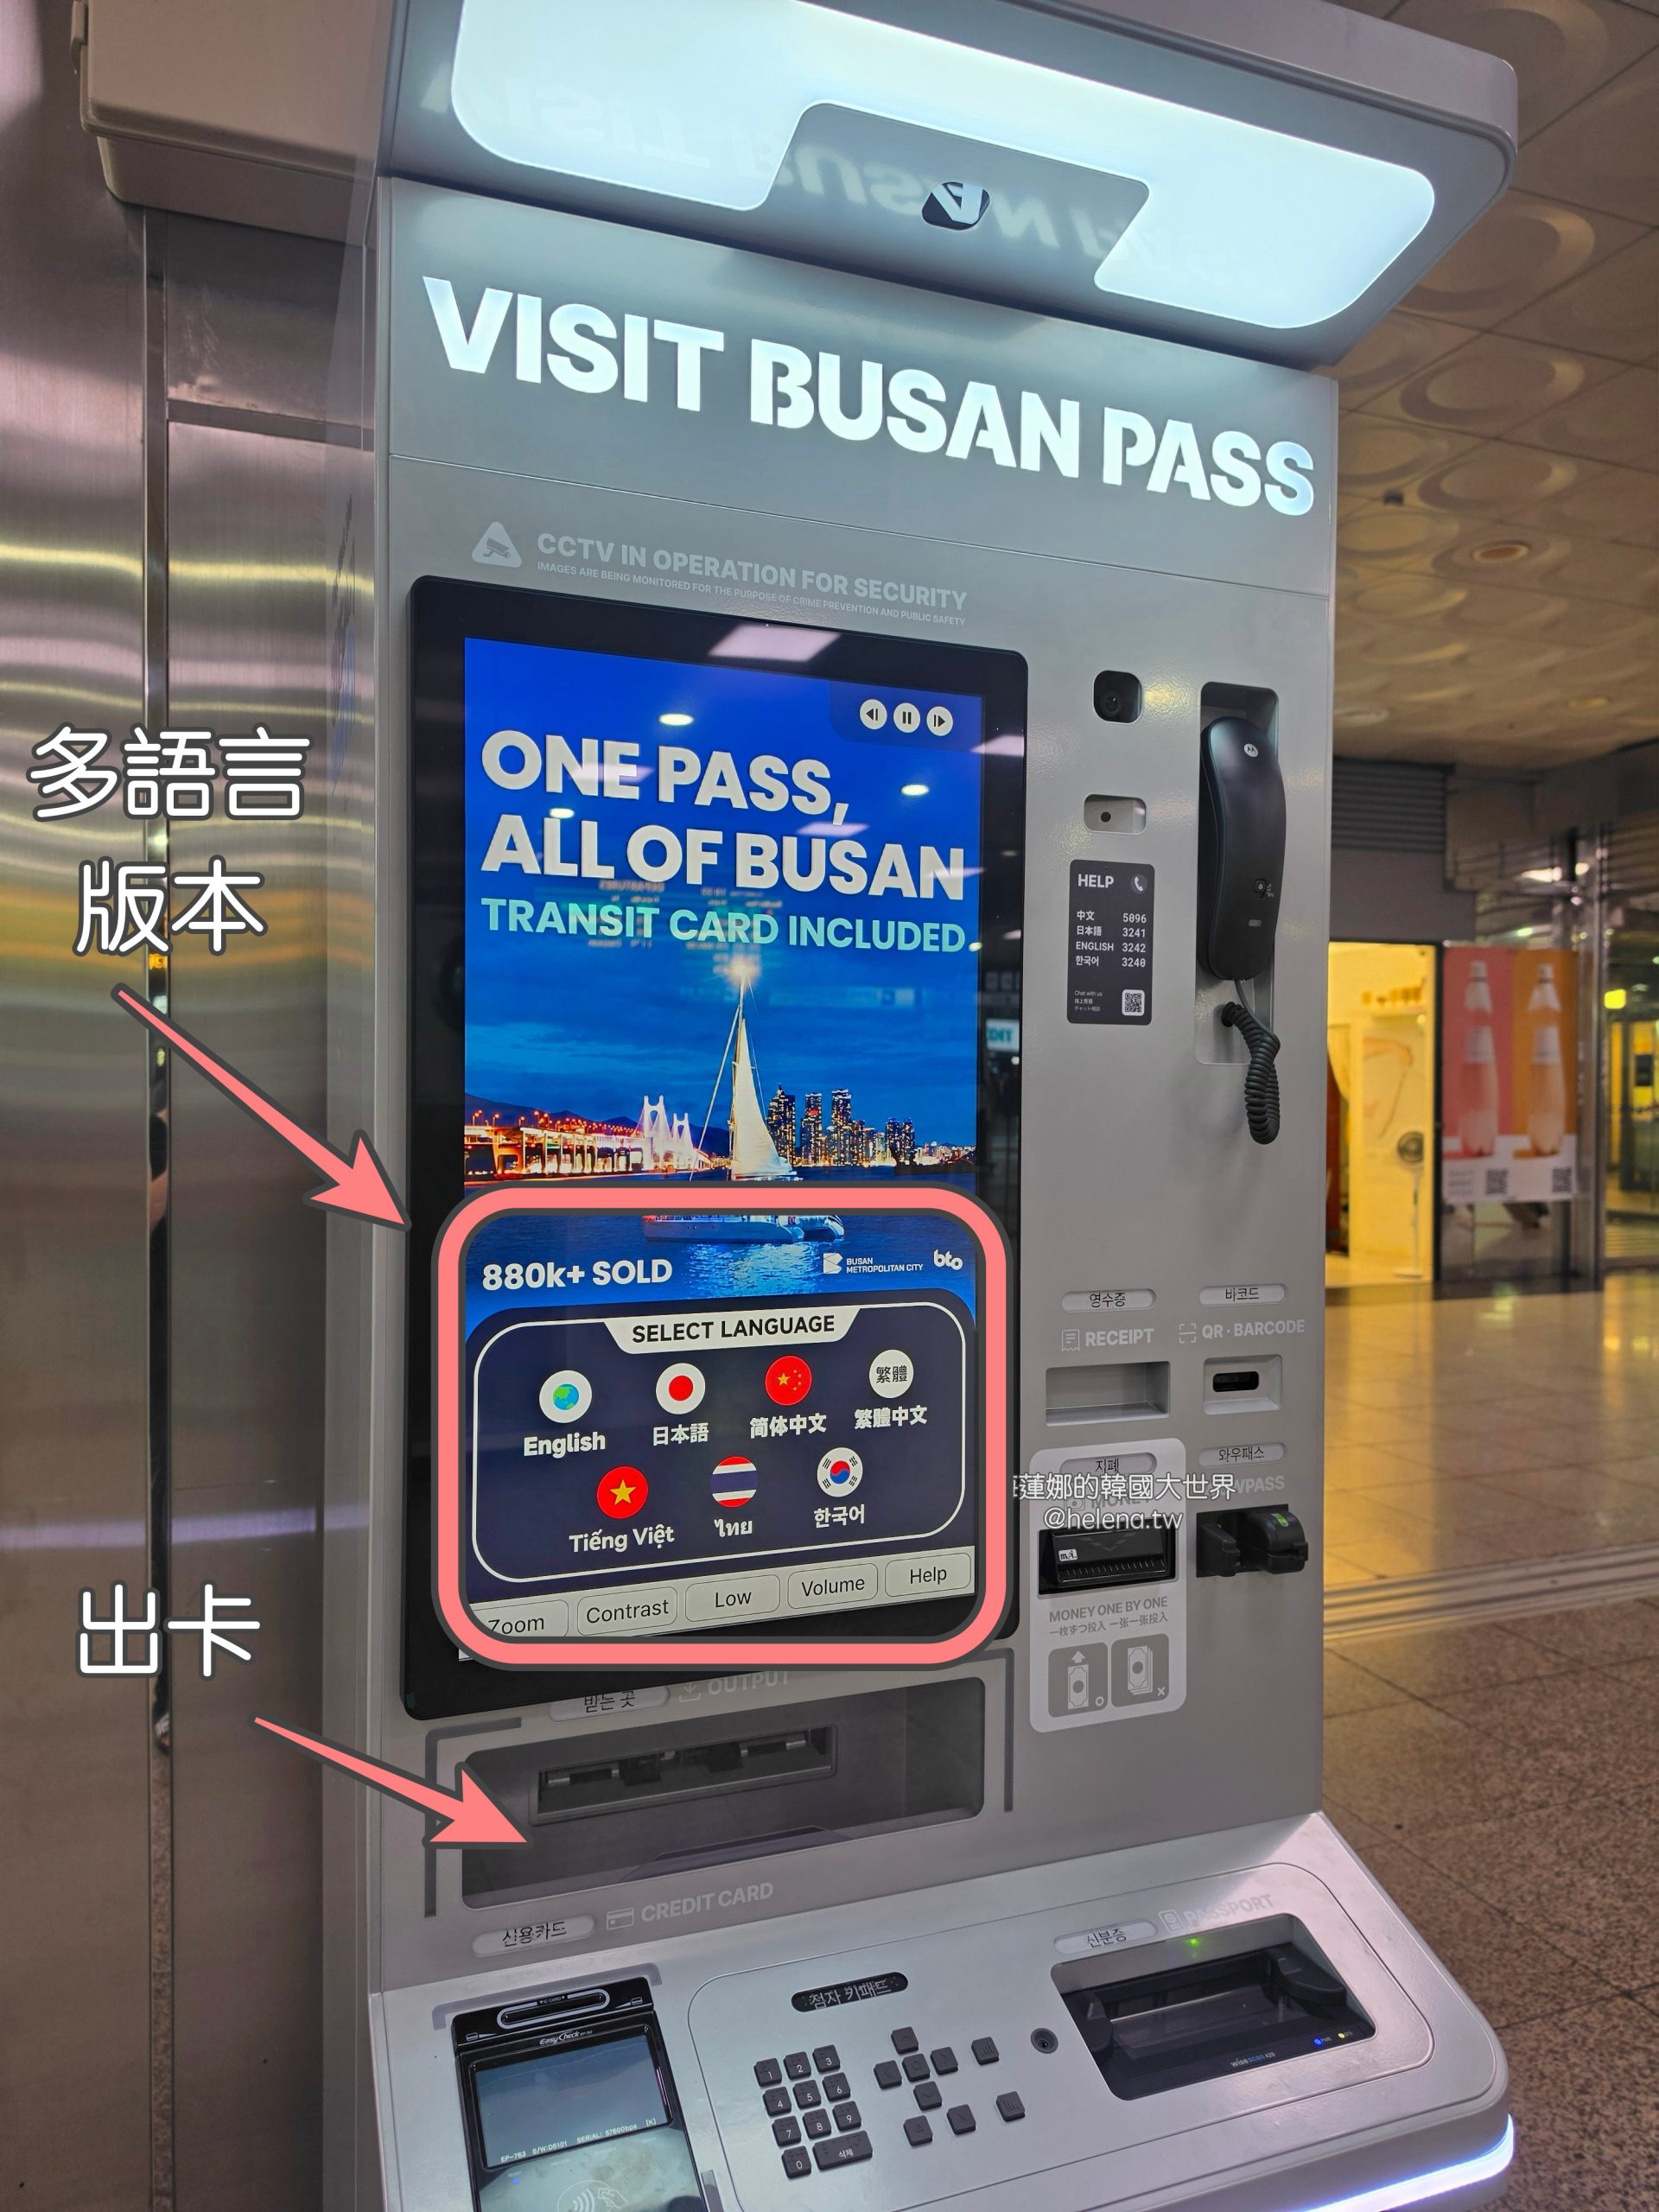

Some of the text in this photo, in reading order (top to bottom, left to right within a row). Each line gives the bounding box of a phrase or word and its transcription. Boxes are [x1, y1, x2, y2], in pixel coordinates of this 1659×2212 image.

[423, 276, 1315, 516] VISIT BUSAN PASS
[537, 533, 967, 610] CCTV IN OPERATION FOR SECURITY
[537, 562, 966, 626] IMAGES ARE BEING MONITORED FOR THE PURPOSE OF CRIME PREVENTION AND PUBLIC SAFETY
[481, 729, 849, 826] ONE PASS,
[480, 813, 965, 901] ALL OF BUSAN
[1077, 874, 1115, 889] HELP
[1077, 910, 1095, 921] 中文
[1122, 912, 1147, 924] 5096
[480, 897, 659, 938] TRANSIT
[670, 908, 779, 944] CARD
[789, 915, 966, 953] INCLUDED
[1077, 925, 1102, 937] 日本語
[1122, 928, 1146, 938] 3241
[1076, 941, 1114, 951] ENGLISH
[1122, 943, 1146, 953] 3242
[1075, 956, 1099, 967] 한국어
[1122, 957, 1146, 968] 3240
[846, 1257, 874, 1266] BUSAN
[933, 1249, 963, 1270] bto
[482, 1258, 673, 1291] 880k+ SOLD
[846, 1263, 923, 1274] METROPOLITAN CITY
[1089, 1292, 1127, 1308] 영수증
[1225, 1287, 1261, 1303] 바코드
[632, 1314, 835, 1344] SELECT LANGUAGE
[1202, 1319, 1306, 1339] QR BARCODE
[1085, 1328, 1154, 1348] RECEIPT
[875, 1364, 907, 1383] 繁體
[854, 1405, 928, 1429] 繁體中文
[652, 1422, 709, 1446] 日本語
[749, 1413, 827, 1439] 简体中文
[524, 1432, 606, 1459] English
[1218, 1446, 1265, 1463] 와우패스
[814, 1503, 865, 1529] 한국어
[714, 1518, 753, 1538] ไทย
[569, 1523, 675, 1553] Tiếng Việt
[910, 1567, 947, 1585] Help
[801, 1576, 865, 1597] Volume
[715, 1591, 752, 1608] Low
[586, 1599, 670, 1624] Contrast
[1049, 1596, 1168, 1624] MONEY ONE BY ONE
[1049, 1621, 1106, 1637] 一枚ずつ投入
[1109, 1611, 1168, 1630] 一张一张投入
[641, 1882, 774, 1923] CREDIT CARD
[502, 1921, 567, 1947] 신용카드
[1087, 1928, 1127, 1948] 신분증
[809, 1980, 892, 2009] 점자 키패드
[539, 2031, 580, 2045] EasyCheck
[797, 2064, 804, 2073] 2
[825, 2057, 832, 2066] 3
[767, 2071, 773, 2080] 1
[806, 2093, 813, 2101] 5
[836, 2085, 842, 2094] 6
[778, 2100, 784, 2108] 4
[816, 2122, 823, 2131] 8
[846, 2114, 853, 2123] 9
[786, 2129, 792, 2139] 7
[500, 2151, 526, 2163] EP-763
[796, 2160, 803, 2170] 0
